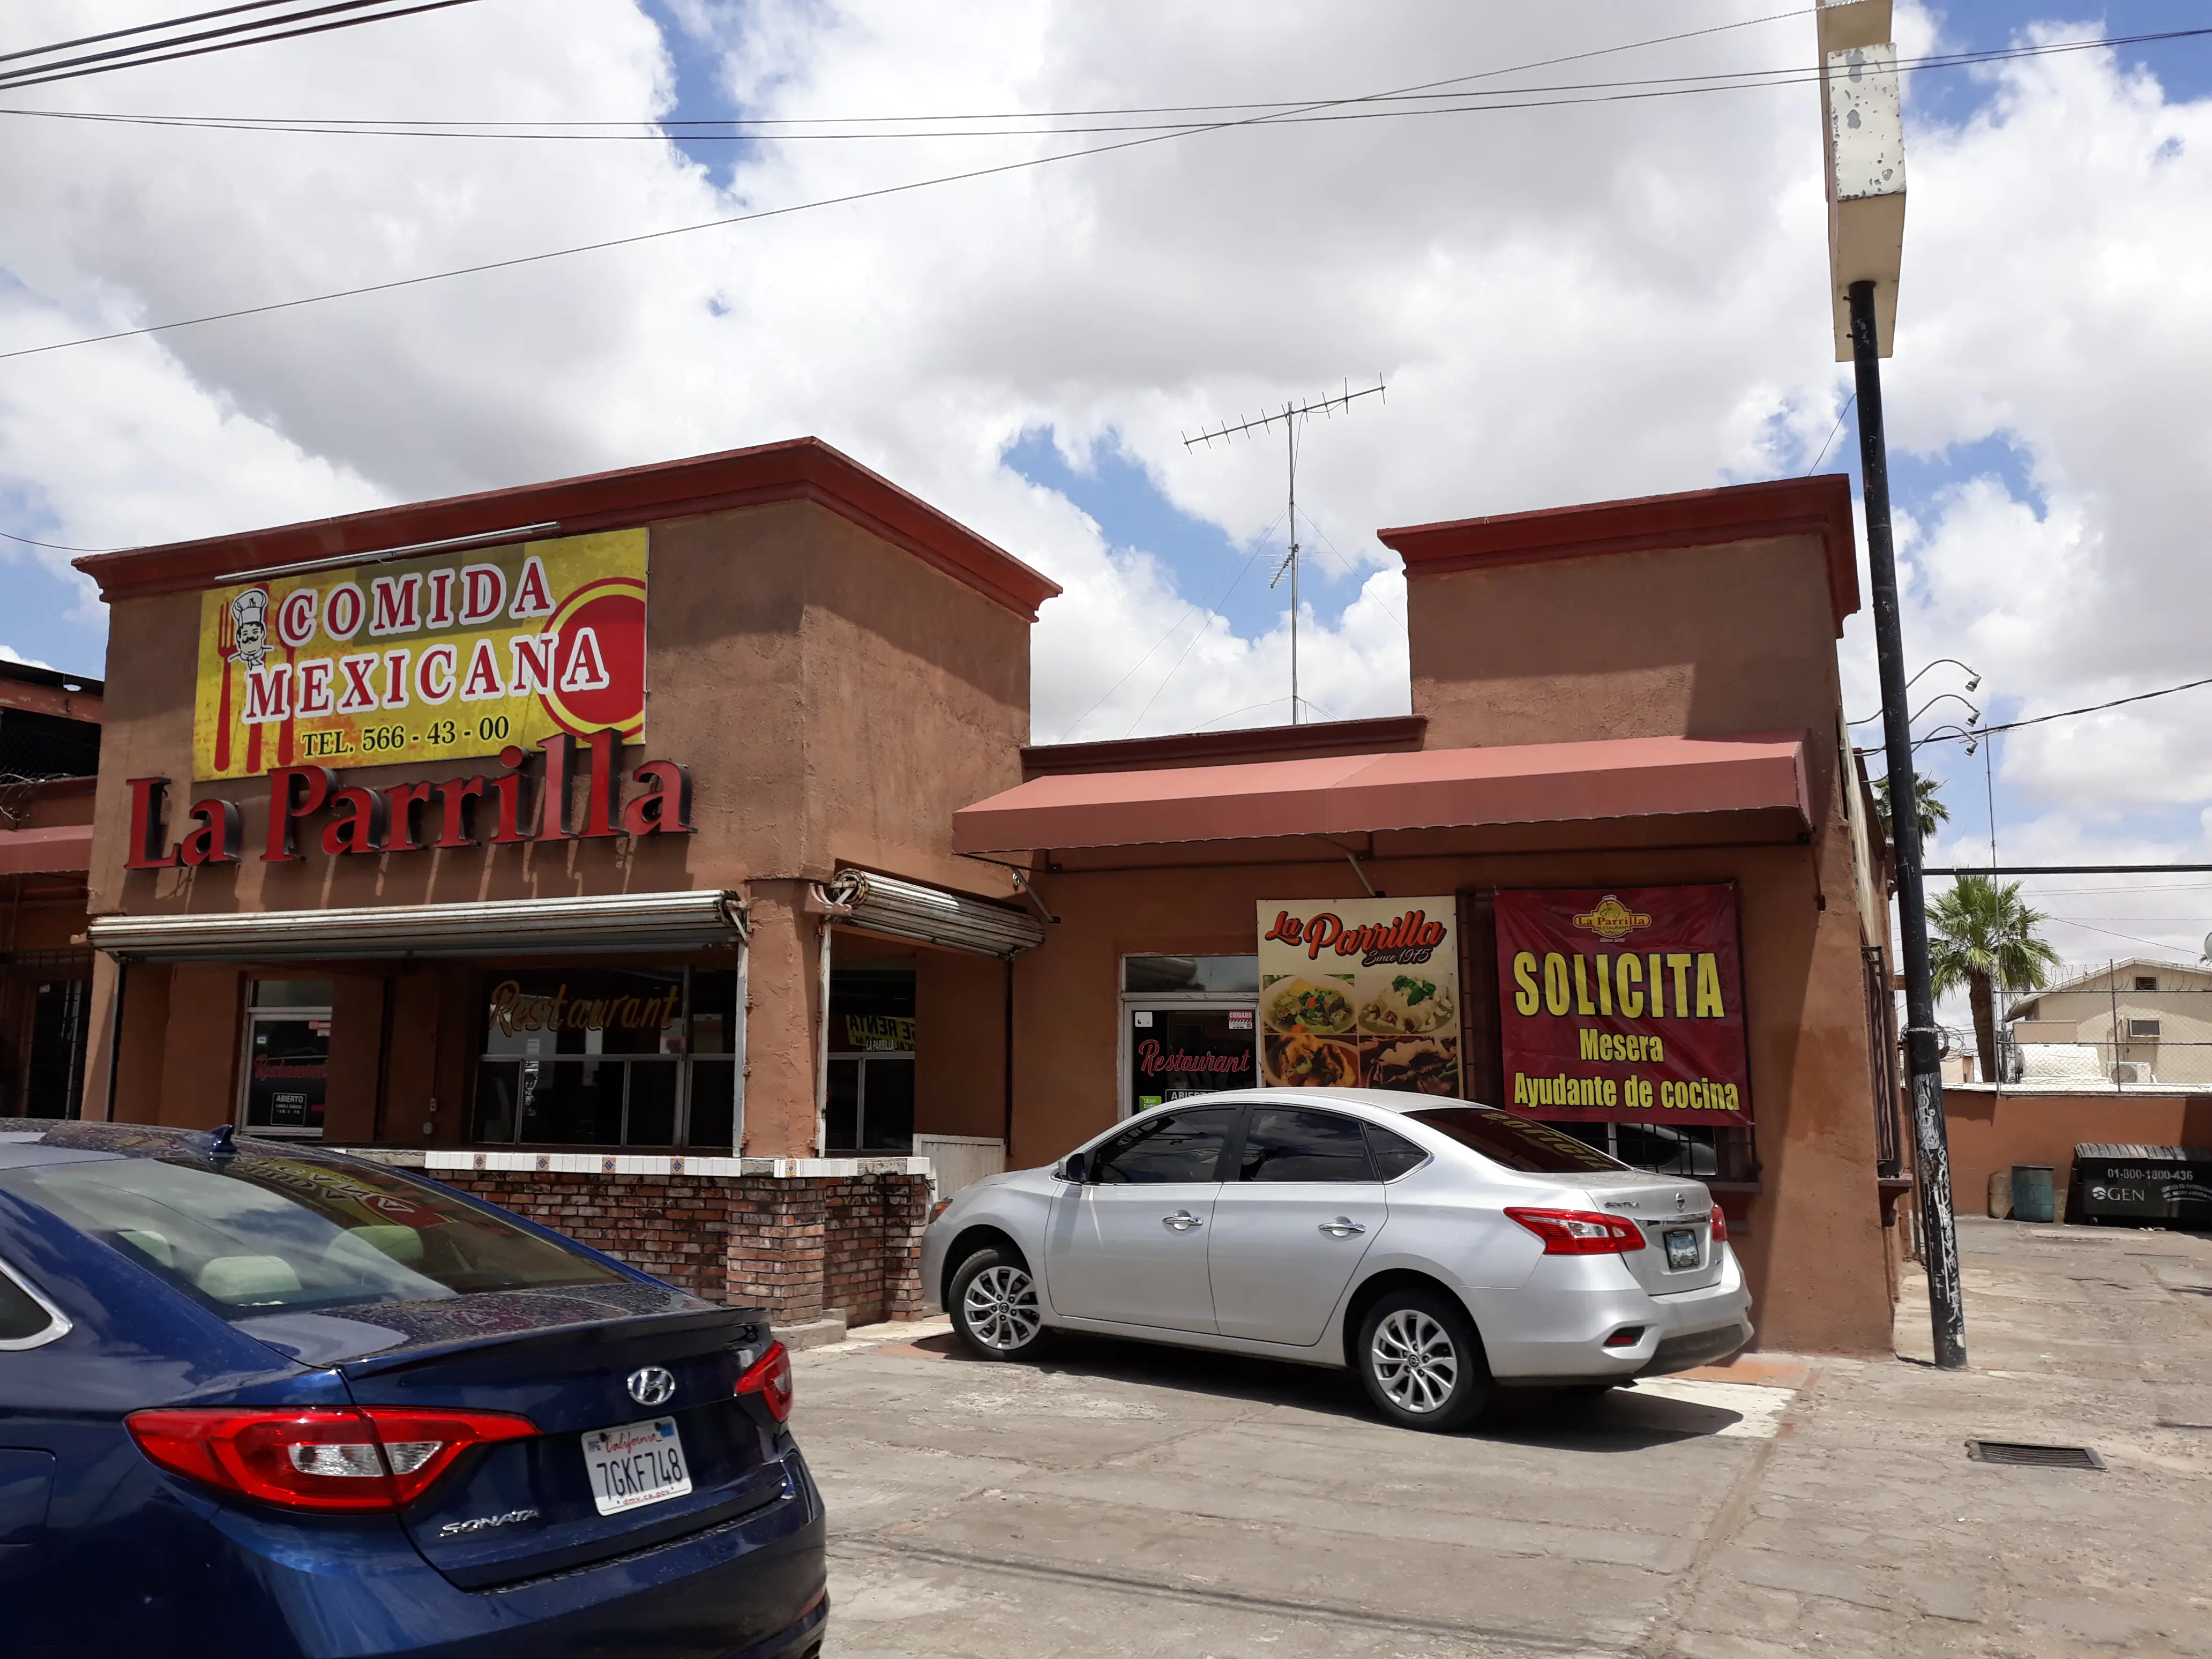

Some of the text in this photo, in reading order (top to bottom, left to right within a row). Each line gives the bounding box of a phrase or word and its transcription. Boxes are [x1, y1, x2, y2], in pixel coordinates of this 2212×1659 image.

[280, 558, 554, 644] COMIDA
[244, 629, 607, 721] MEXICANA
[302, 729, 354, 757] TEL.
[362, 726, 405, 749] 566
[428, 722, 455, 745] 43
[479, 716, 509, 740] 00
[124, 728, 697, 869] La Parrilla
[1265, 910, 1447, 960] La Parrilla
[1579, 917, 1645, 925] La Parrilla
[1364, 948, 1431, 965] Since 1975
[1513, 951, 1725, 1018] SOLICITA
[490, 980, 679, 1037] Restaurant
[1139, 1039, 1250, 1077] Restaurant
[1579, 1028, 1664, 1062] Mesera
[275, 1094, 304, 1103] ABIERTO
[1514, 1072, 1740, 1111] Ayudante de cocina
[2108, 1187, 2146, 1202] GEN
[606, 1431, 662, 1454] California
[596, 1448, 683, 1499] 7GKF748
[439, 1508, 540, 1538] SONATA
